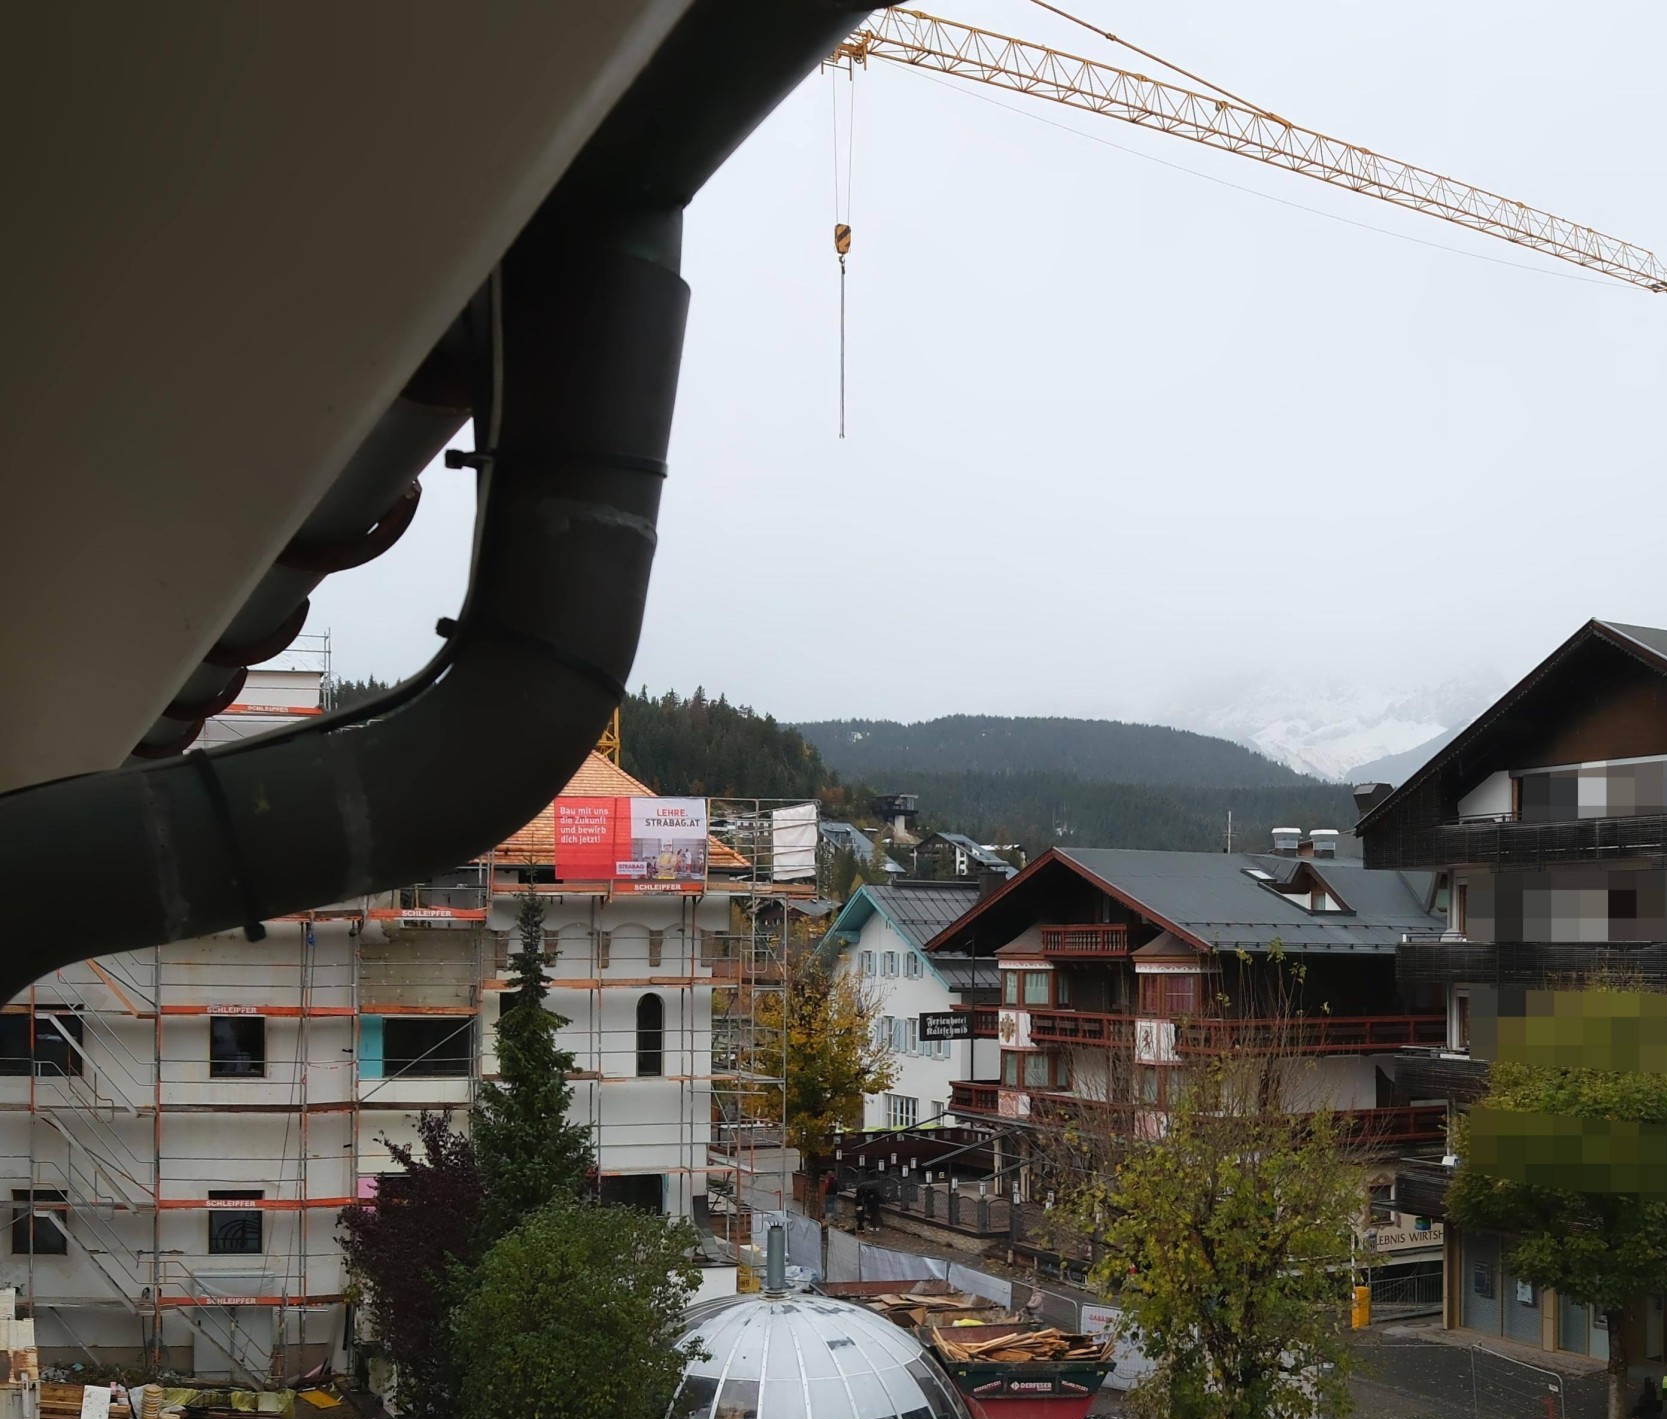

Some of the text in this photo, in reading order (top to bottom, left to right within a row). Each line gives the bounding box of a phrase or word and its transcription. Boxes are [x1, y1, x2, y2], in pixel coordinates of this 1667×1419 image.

[560, 807, 576, 815] Bau
[578, 806, 592, 815] mit
[656, 809, 688, 817] LEHRE.
[645, 819, 700, 827] STRABAG.AT
[577, 826, 606, 834] bewirb
[579, 836, 600, 844] jetzt!
